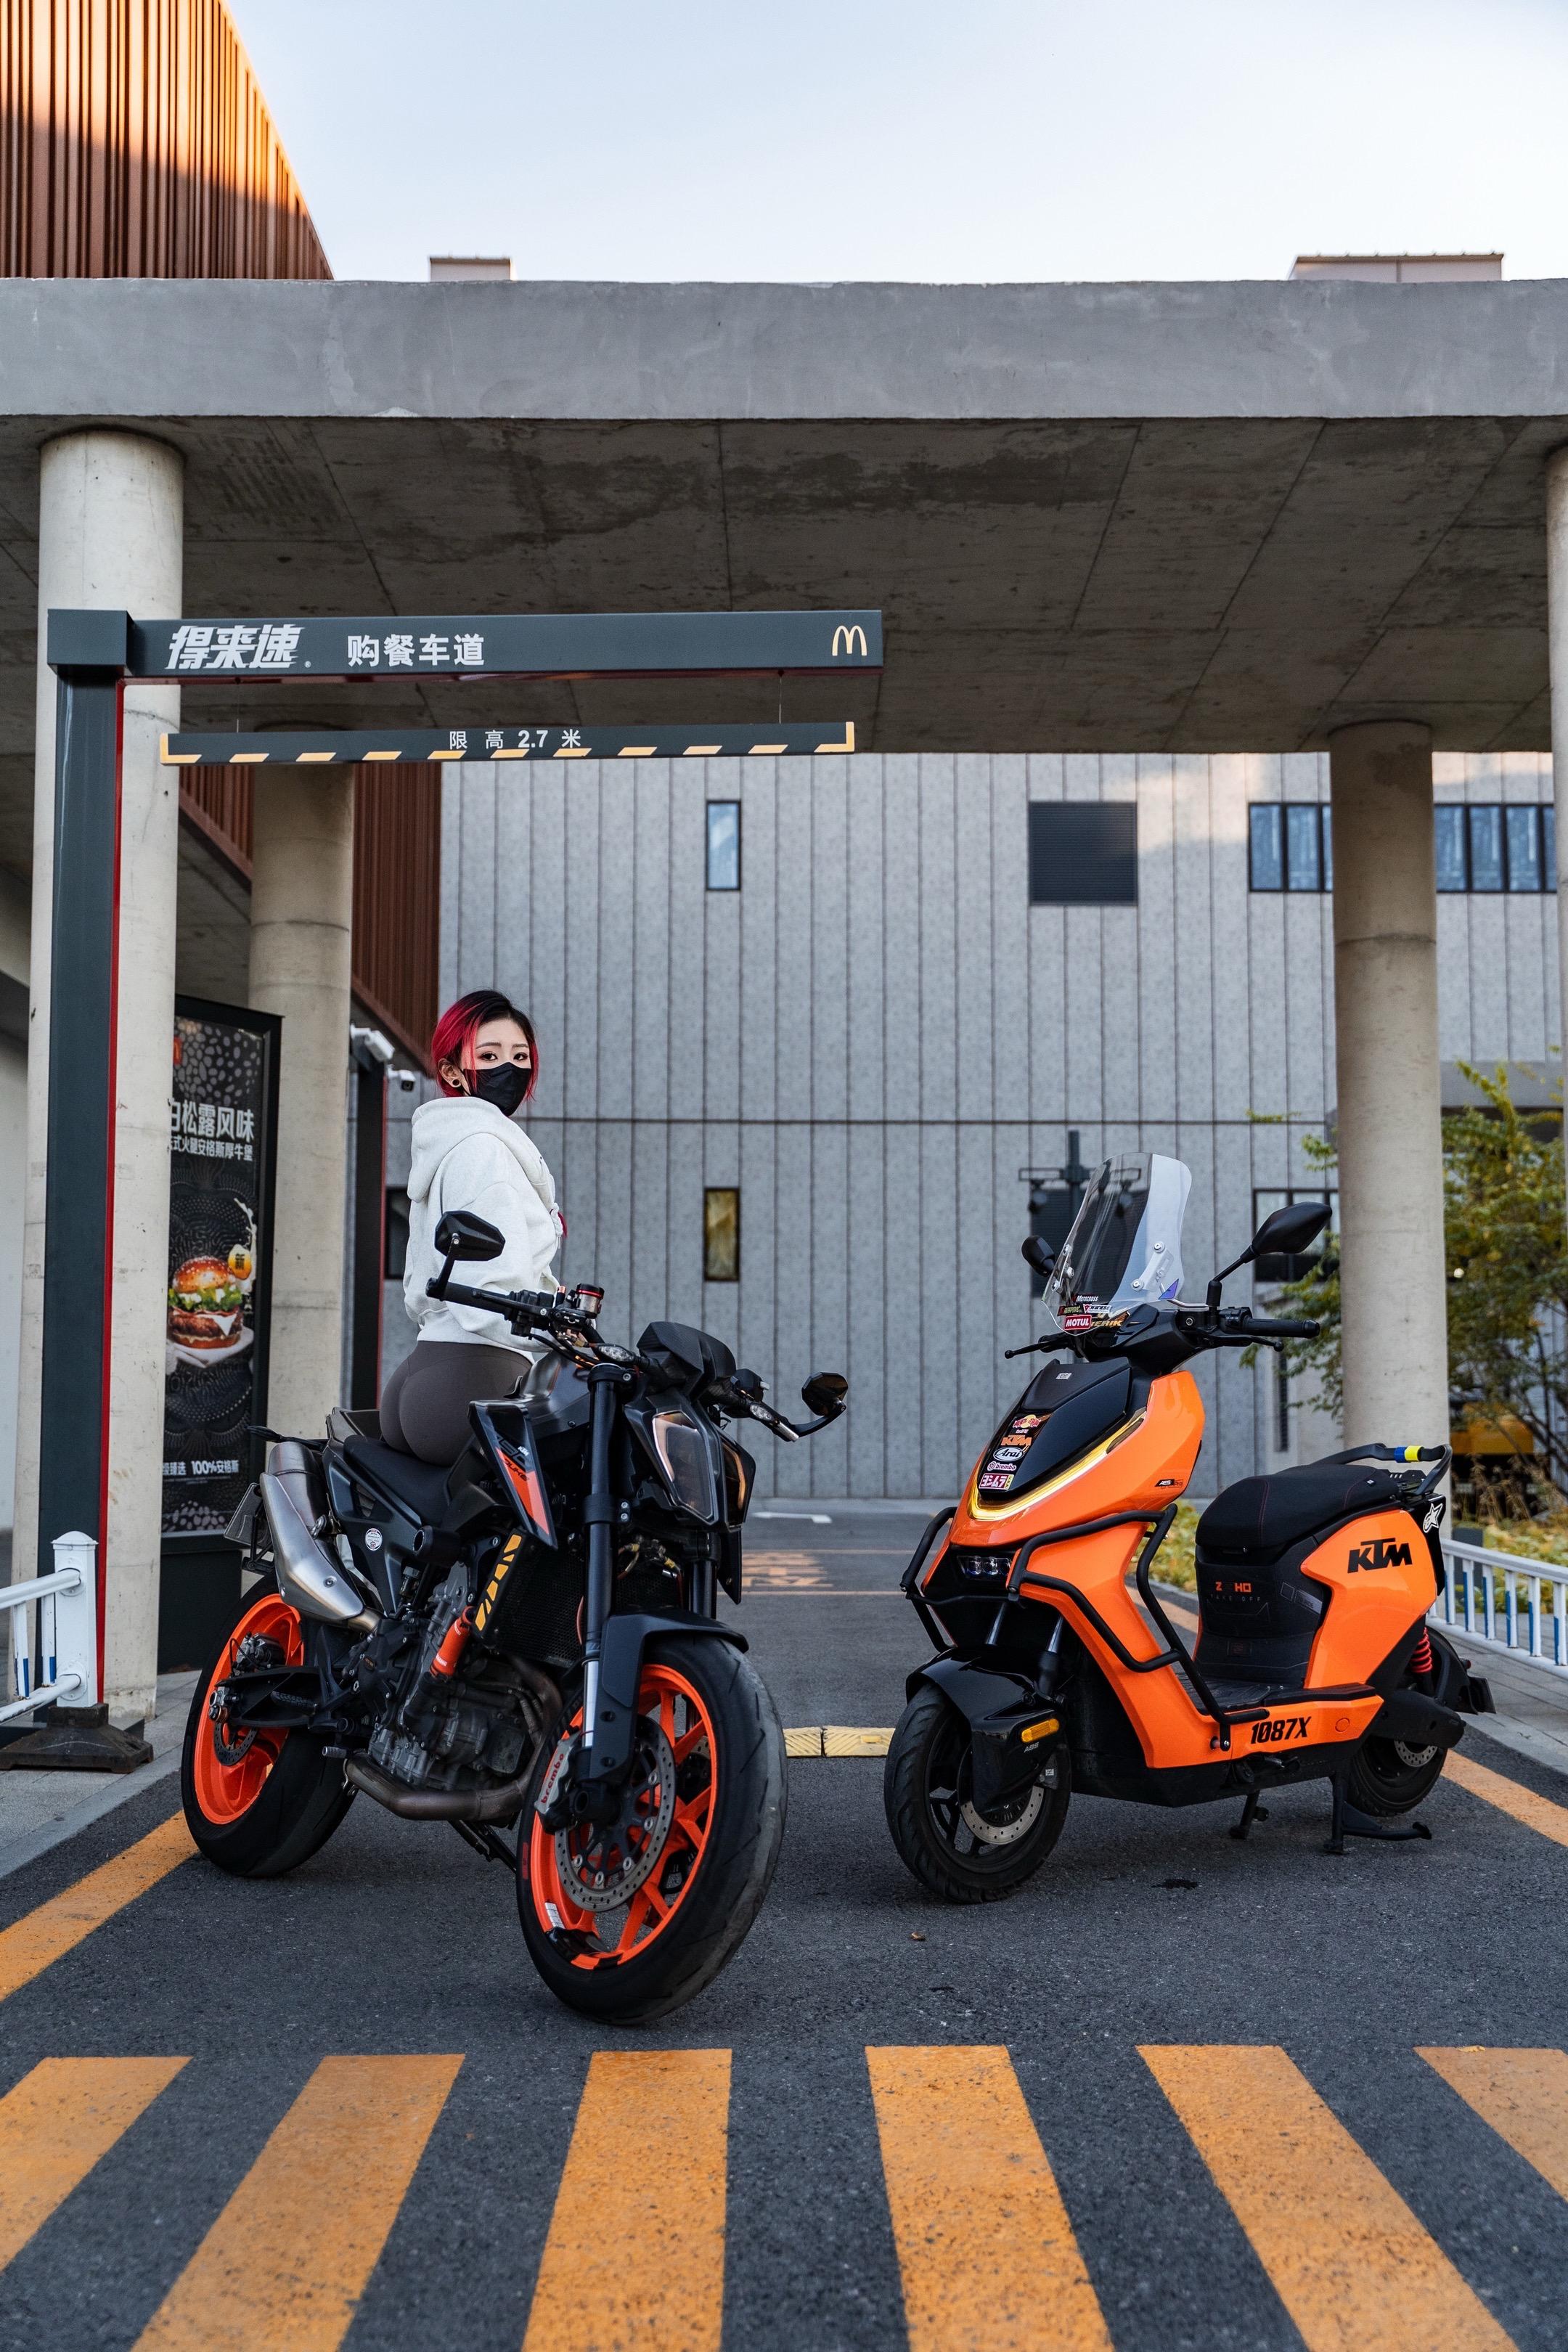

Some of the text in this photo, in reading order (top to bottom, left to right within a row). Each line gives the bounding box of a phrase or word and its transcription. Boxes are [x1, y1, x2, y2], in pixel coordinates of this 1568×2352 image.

[347, 633, 484, 666] 购餐车道
[518, 730, 549, 748] 2.7
[171, 1135, 253, 1161] 式火腿安格斯厚牛堡
[1066, 1318, 1090, 1327] MOTUL
[1001, 1434, 1032, 1445] KTM
[995, 1448, 1022, 1457] Arai
[1347, 1538, 1413, 1573] KTM
[1251, 1716, 1312, 1744] 1087X
[1024, 1741, 1039, 1752] ABS
[541, 1753, 564, 1803] brembo
